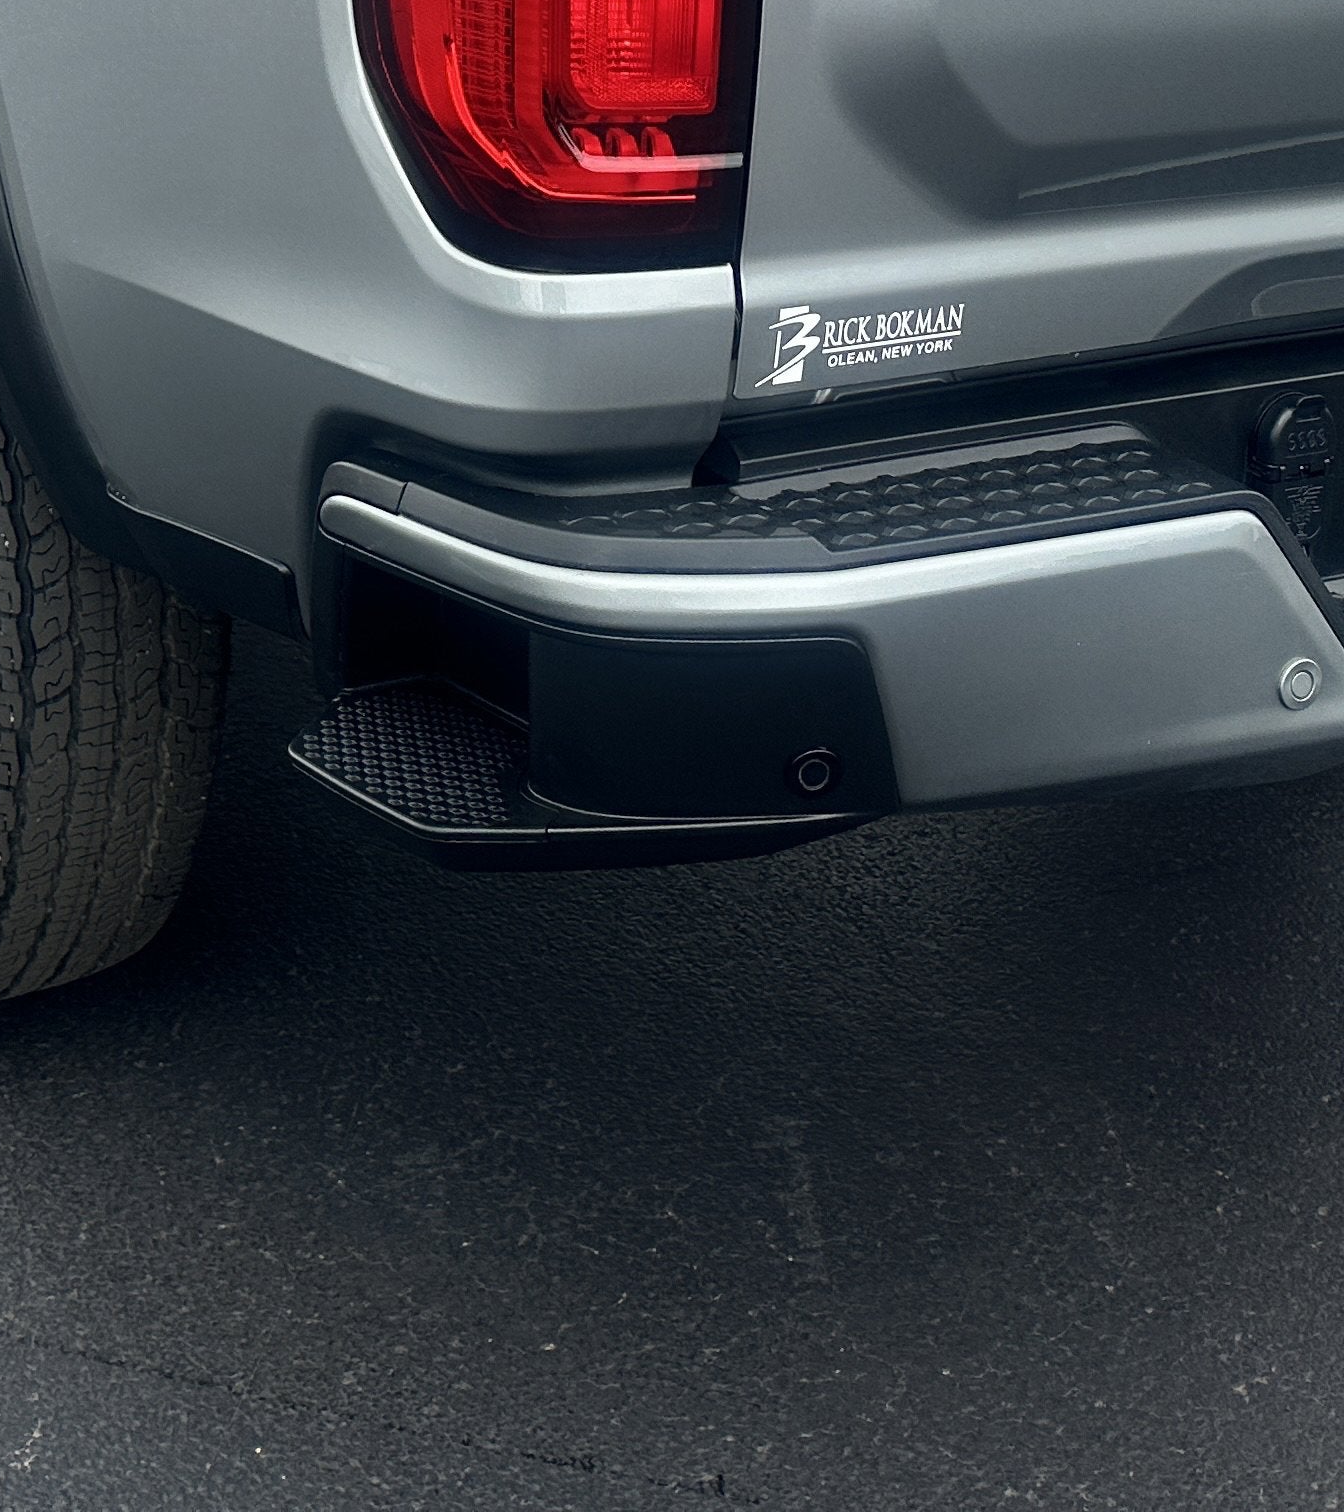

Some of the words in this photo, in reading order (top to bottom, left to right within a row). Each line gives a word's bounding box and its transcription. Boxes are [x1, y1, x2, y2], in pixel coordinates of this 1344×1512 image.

[822, 314, 872, 348] RICK
[875, 303, 966, 339] BOKMAN
[827, 348, 879, 369] OLEAN,
[881, 342, 914, 361] NEW
[914, 338, 954, 356] YORK
